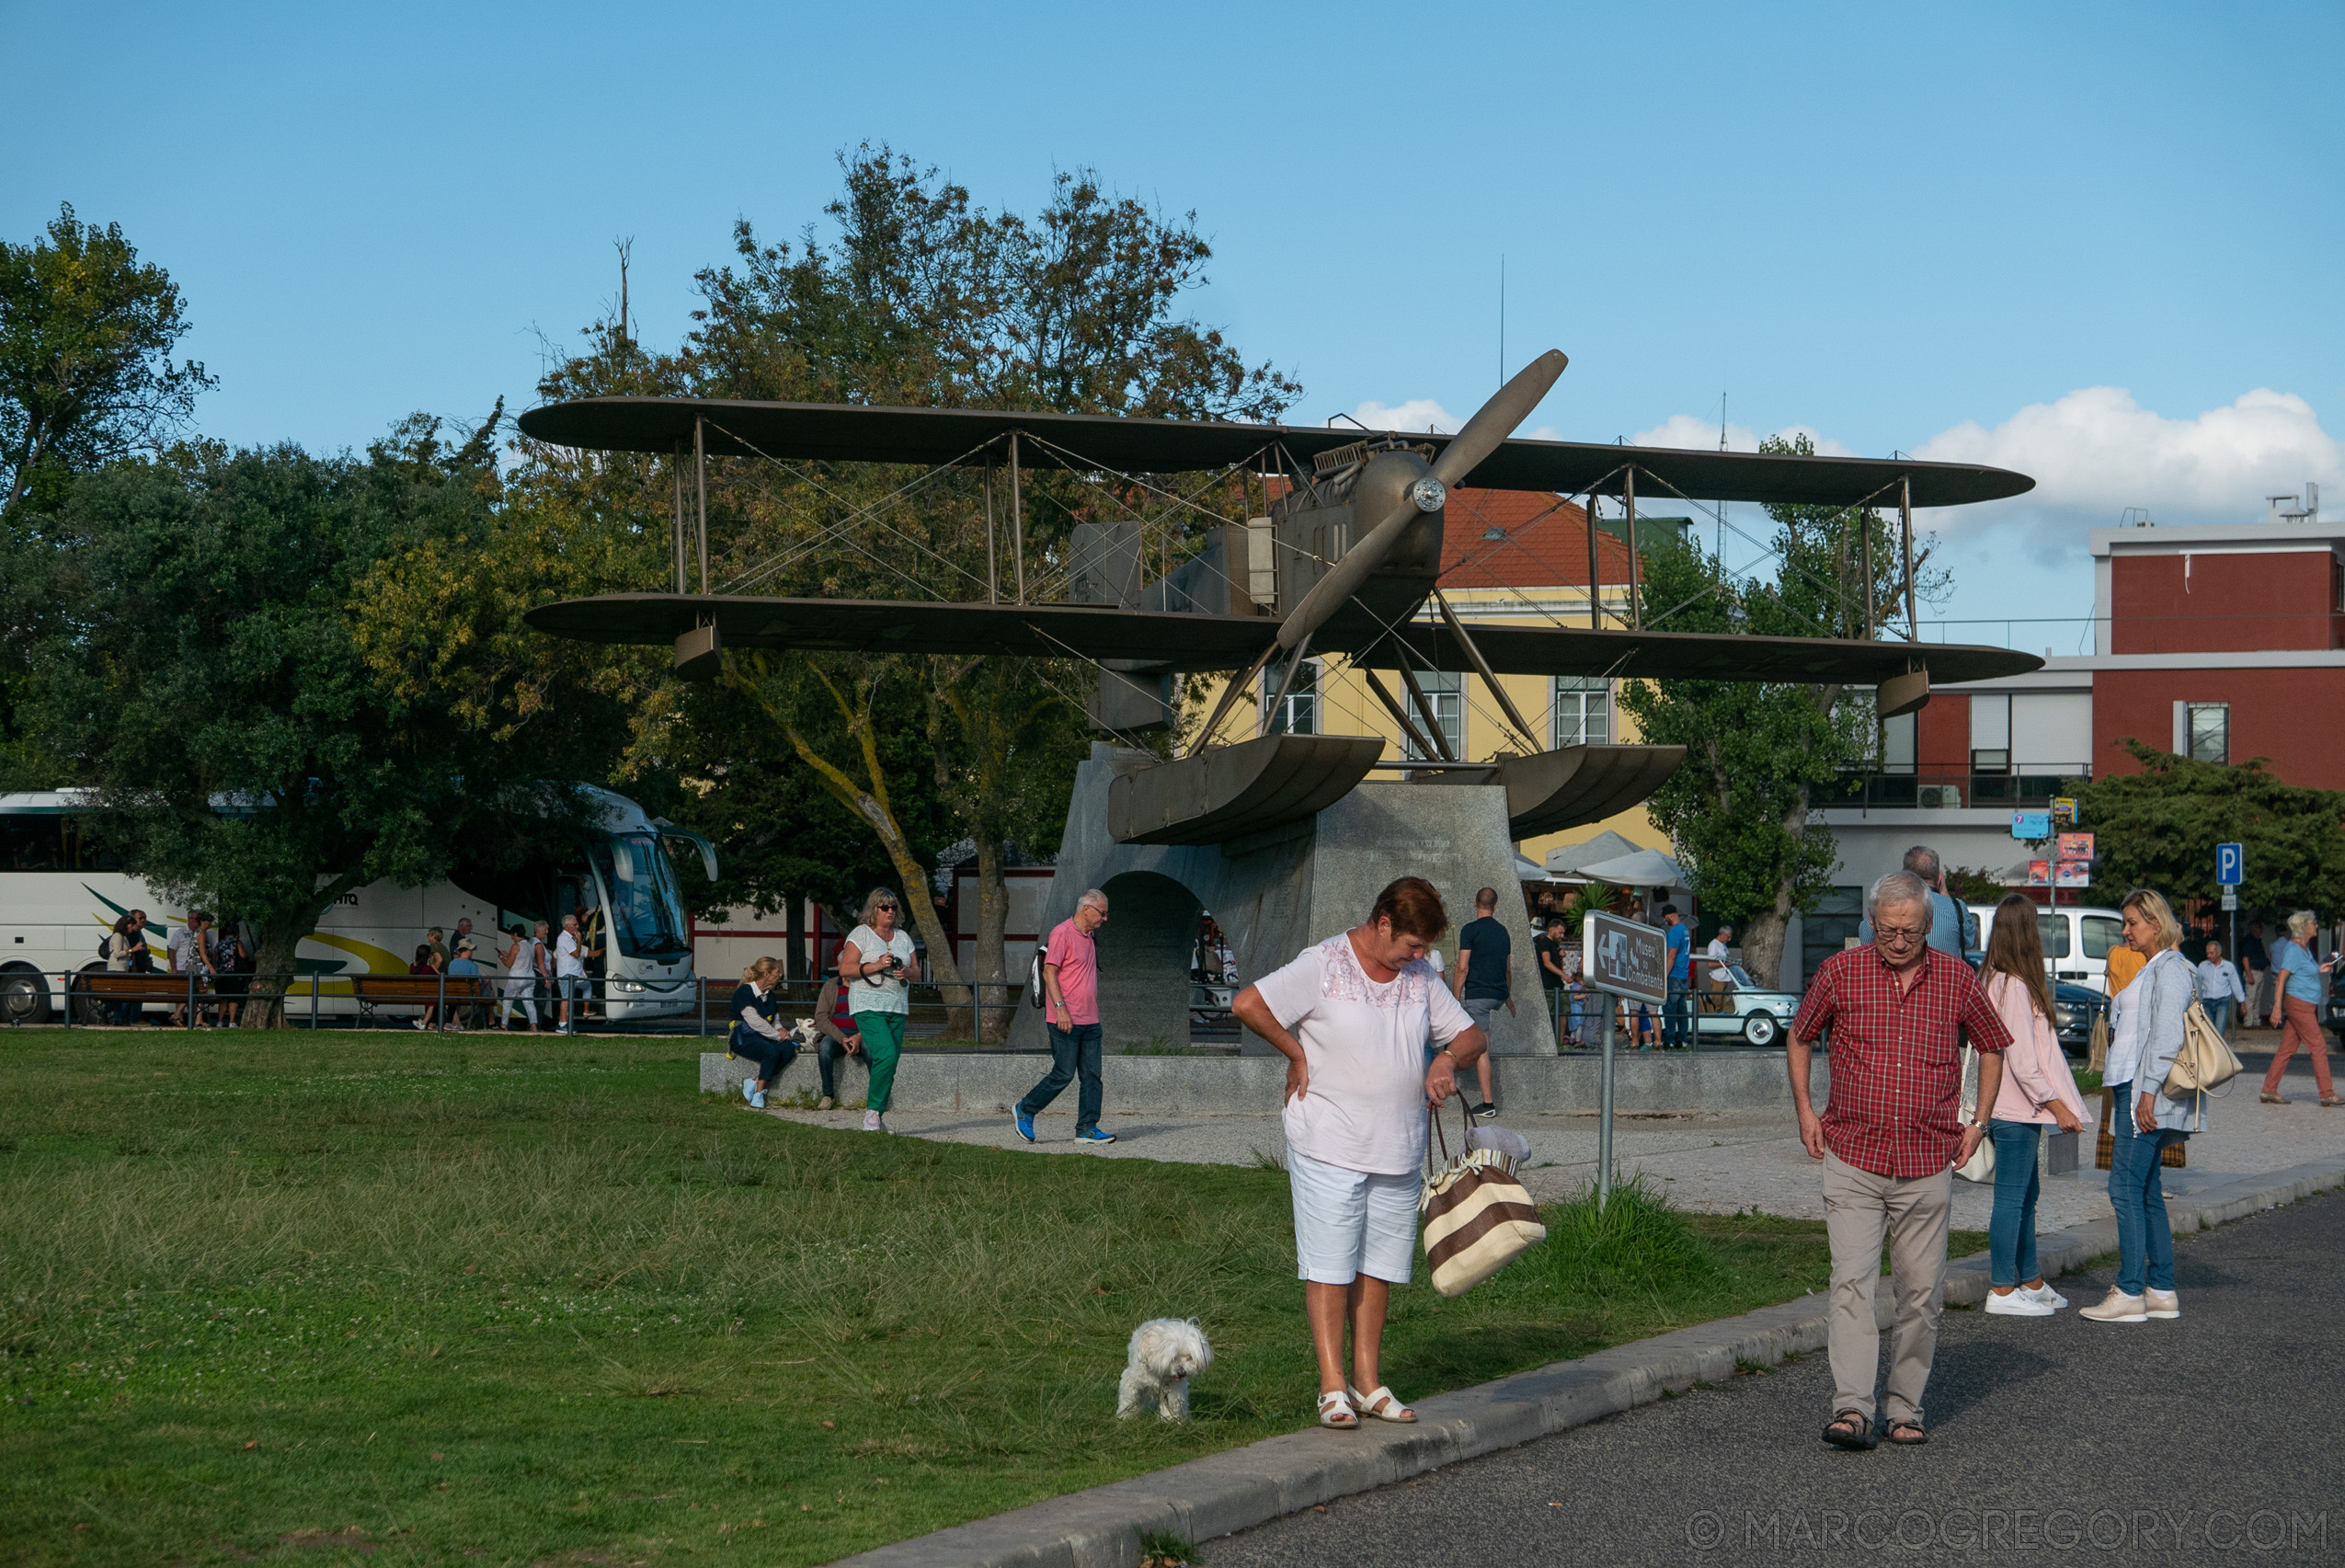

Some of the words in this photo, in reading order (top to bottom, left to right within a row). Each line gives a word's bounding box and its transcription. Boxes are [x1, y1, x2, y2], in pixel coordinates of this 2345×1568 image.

[2222, 848, 2236, 880] P
[1635, 937, 1654, 958] Museu
[1642, 959, 1649, 969] do
[1627, 965, 1664, 990] Combatente
